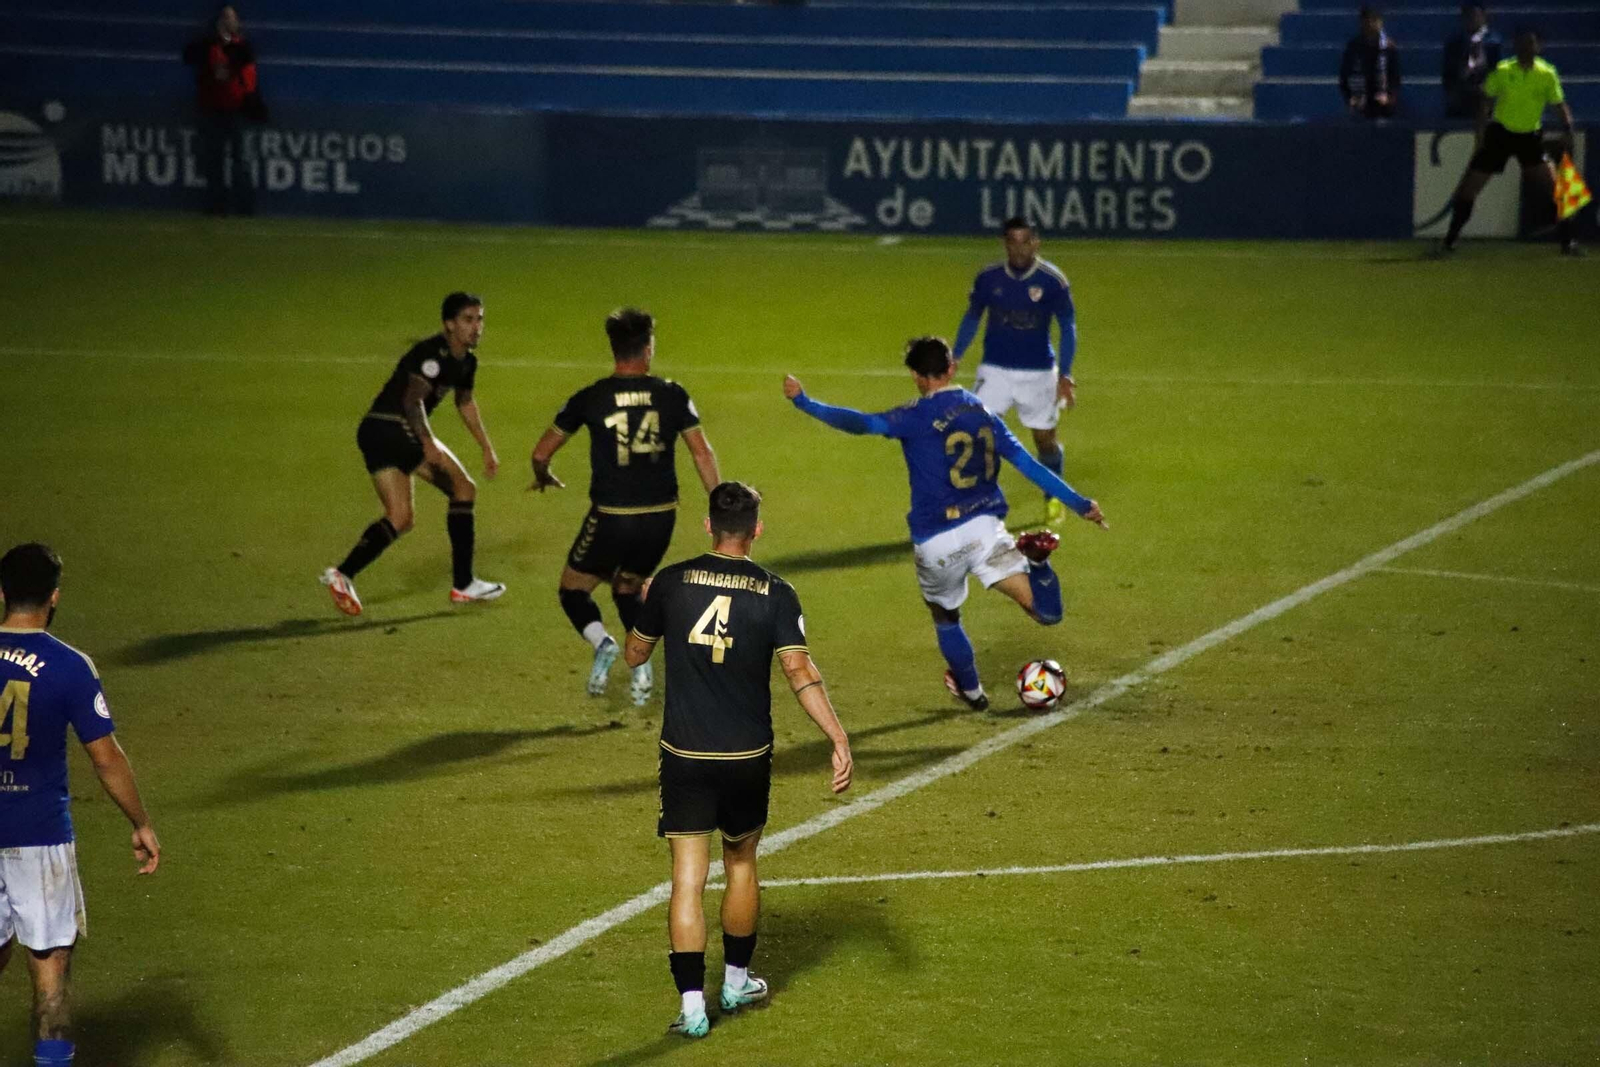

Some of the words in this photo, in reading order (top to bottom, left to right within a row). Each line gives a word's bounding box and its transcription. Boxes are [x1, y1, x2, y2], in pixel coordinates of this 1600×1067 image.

[843, 137, 1214, 184] AYUNTAMIENTO
[876, 186, 935, 227] de
[981, 186, 1177, 231] LINARES
[604, 409, 665, 466] 14
[942, 424, 996, 489] 21
[688, 594, 734, 664] 4
